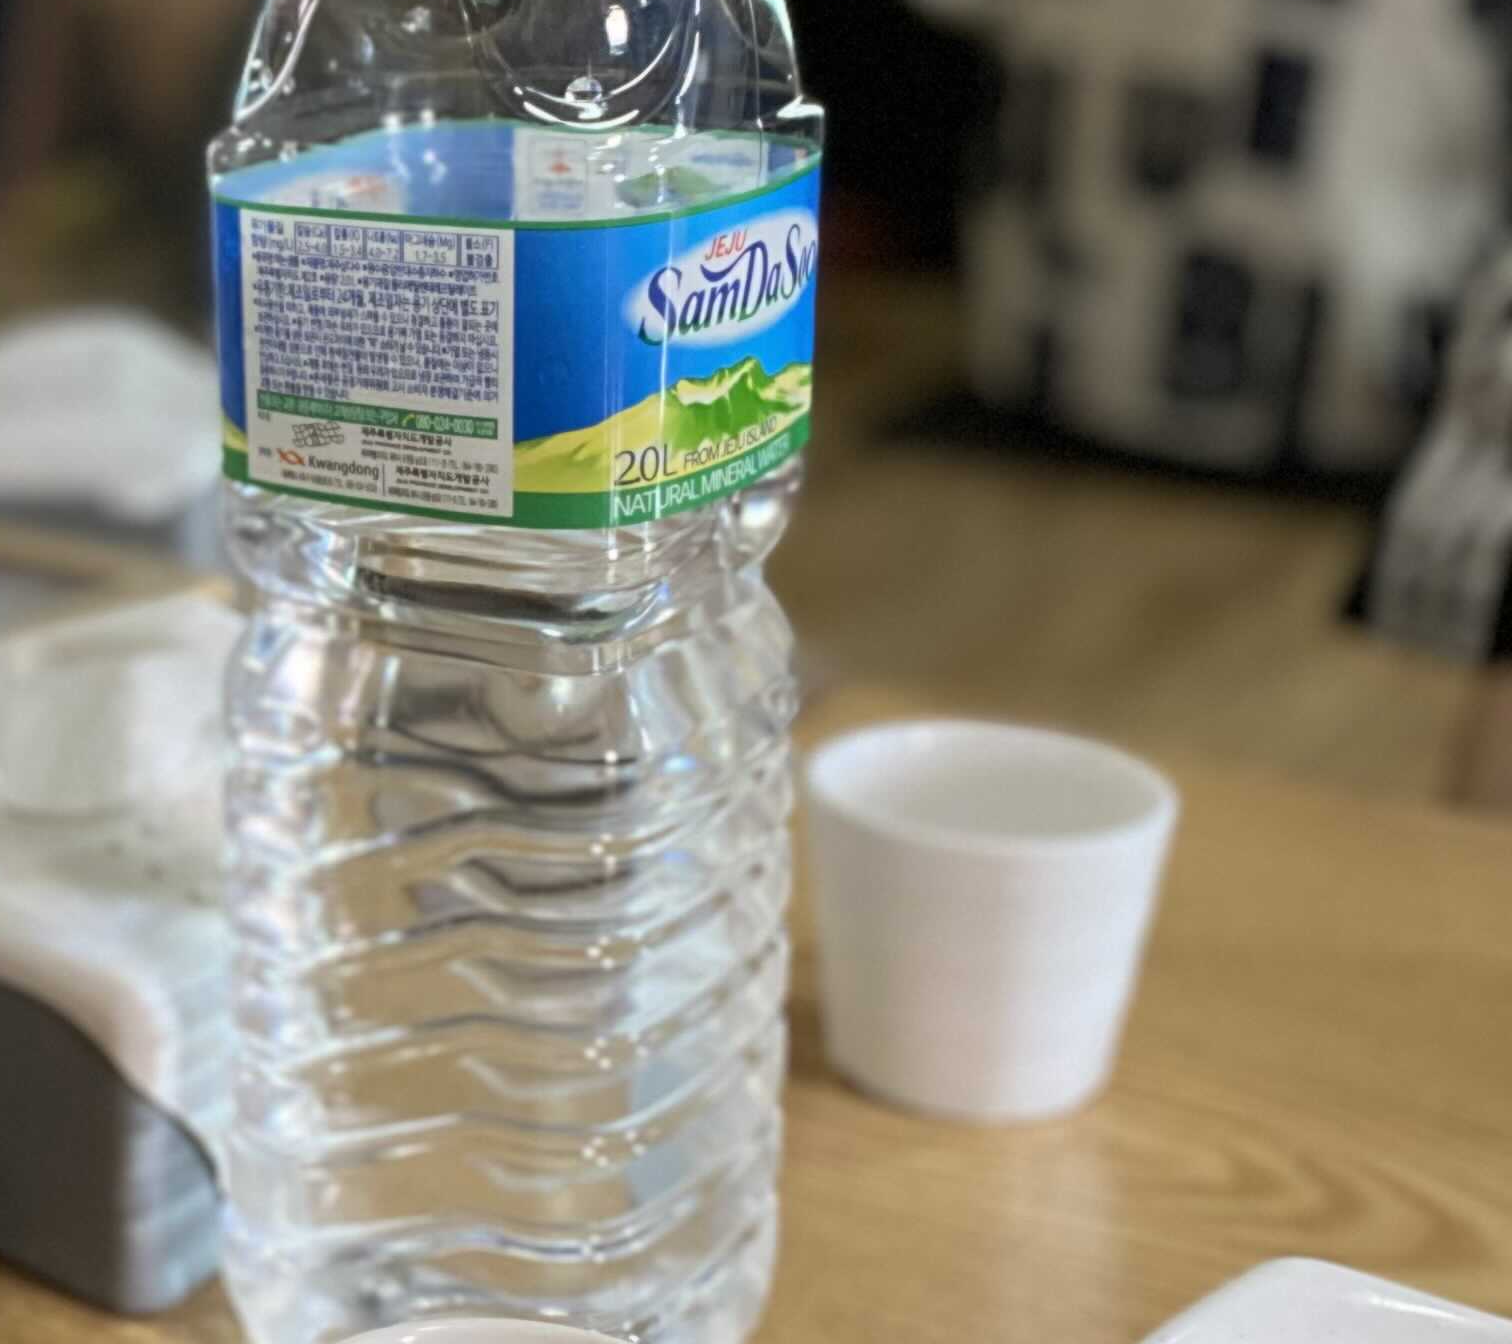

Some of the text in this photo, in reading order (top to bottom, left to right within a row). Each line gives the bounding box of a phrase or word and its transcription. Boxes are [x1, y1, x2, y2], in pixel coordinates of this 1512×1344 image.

[705, 228, 748, 261] JEJU
[308, 455, 379, 480] Kwangdong
[683, 442, 722, 470] FROM
[614, 478, 699, 518] NATURAL
[701, 456, 758, 495] MINERAL
